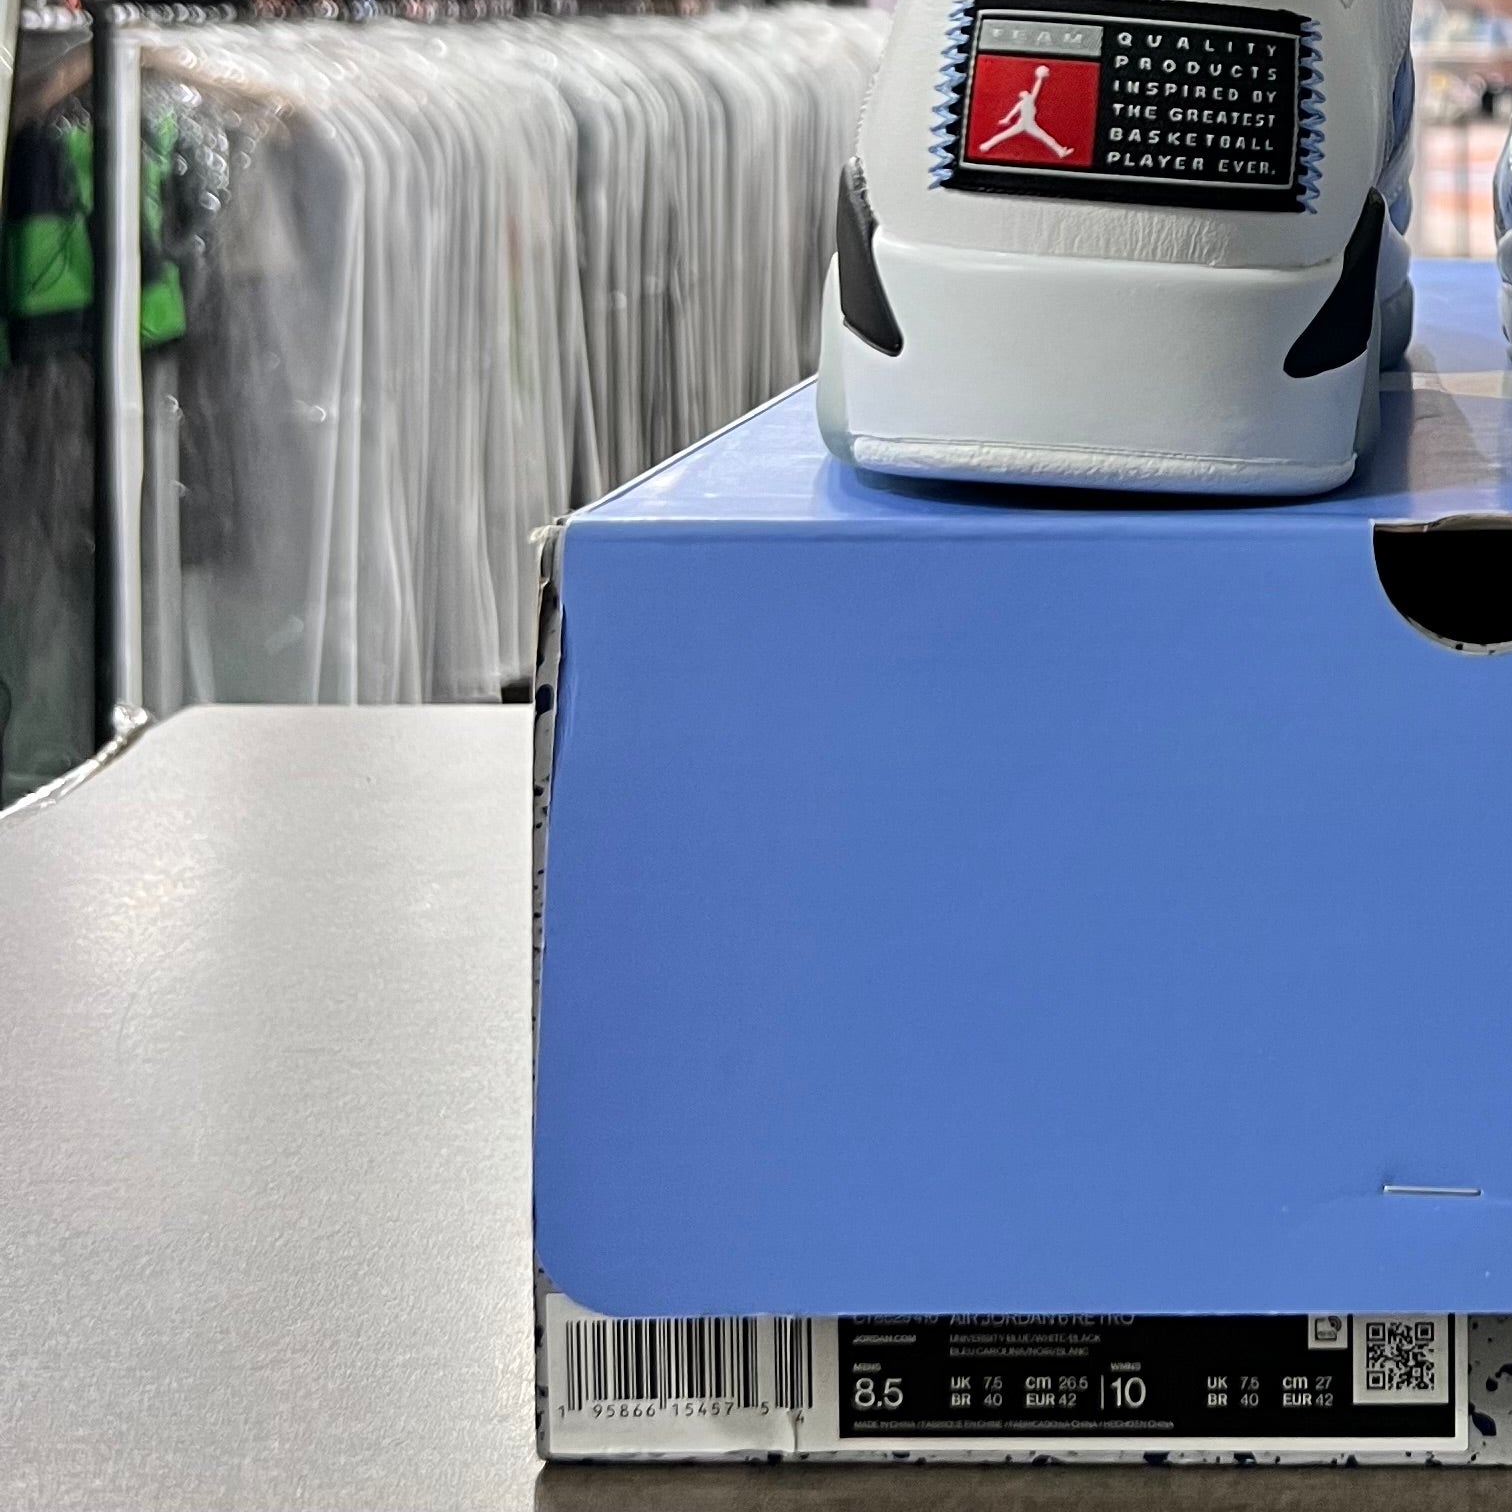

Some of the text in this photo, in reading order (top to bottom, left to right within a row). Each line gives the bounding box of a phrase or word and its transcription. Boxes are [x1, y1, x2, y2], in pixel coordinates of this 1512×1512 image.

[989, 27, 1082, 45] TEAM
[1117, 32, 1277, 57] QUALITY
[1114, 55, 1277, 81] PRODUCTS
[1113, 80, 1277, 103] INSPIRED BY
[1112, 103, 1275, 127] THE GREATEST
[1110, 127, 1274, 151] BASKETBALL
[1106, 151, 1276, 175] PLAYER EVER.
[854, 1377, 904, 1407] 8.5
[951, 1376, 971, 1390] UK
[1025, 1376, 1051, 1390] cm
[1111, 1377, 1147, 1408] 10
[1207, 1376, 1228, 1390] UK
[1282, 1375, 1308, 1389] cm
[1315, 1375, 1332, 1389] 27
[592, 1403, 656, 1418] 95866
[672, 1402, 735, 1417] 15457
[761, 1401, 770, 1416] 5
[951, 1393, 1077, 1407] BR 40 EUR 42
[1207, 1393, 1333, 1406] BR 40 EUR 42
